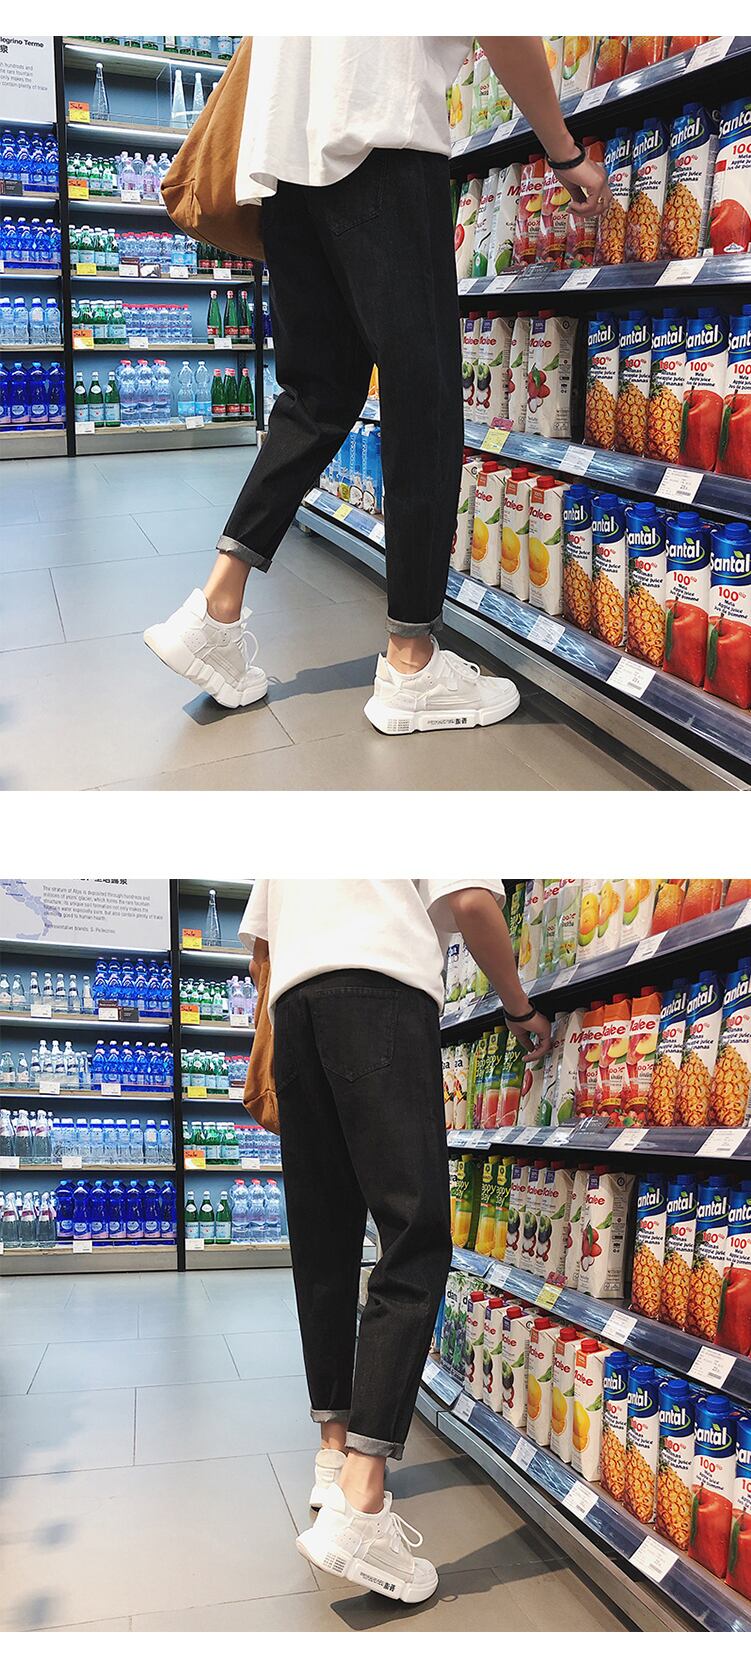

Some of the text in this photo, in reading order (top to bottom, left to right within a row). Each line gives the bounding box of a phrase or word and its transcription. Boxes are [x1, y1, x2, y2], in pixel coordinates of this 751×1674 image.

[605, 139, 630, 165] antal
[633, 130, 659, 159] antal
[588, 325, 611, 344] antal
[620, 325, 647, 348] antal
[690, 361, 714, 372] 100%
[563, 505, 584, 521] antal
[592, 516, 615, 533] antal
[710, 552, 751, 573] Santal
[673, 571, 698, 586] 100%
[718, 586, 747, 602] 100%
[660, 993, 687, 1019] antal
[687, 985, 713, 1014] antal
[482, 1184, 496, 1195] appy
[496, 1185, 510, 1197] appy
[638, 1188, 660, 1208] antal
[666, 1192, 693, 1213] antal
[728, 1204, 751, 1223] anta
[603, 1375, 622, 1390] antal
[627, 1390, 648, 1407] antal
[658, 1408, 686, 1426] antal
[699, 1456, 723, 1473] 100%
